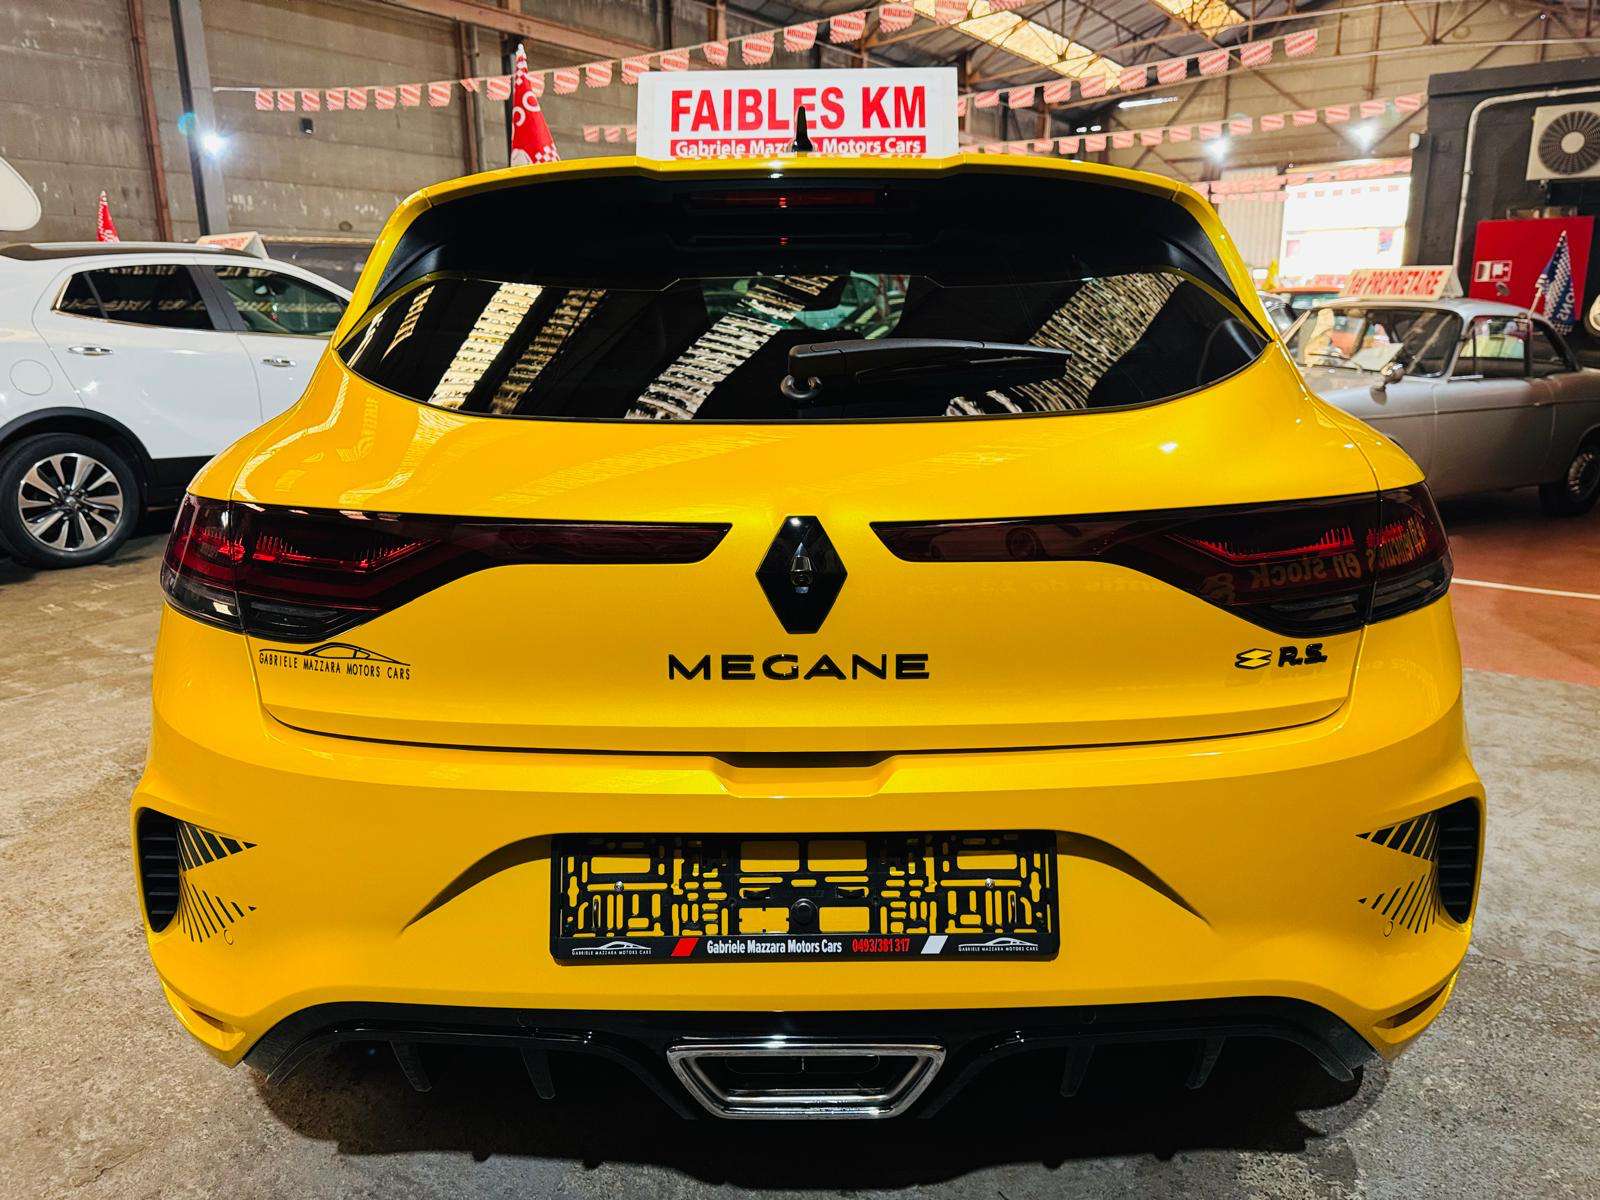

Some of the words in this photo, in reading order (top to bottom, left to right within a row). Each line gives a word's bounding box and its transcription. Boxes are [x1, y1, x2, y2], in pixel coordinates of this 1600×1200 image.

[670, 86, 845, 132] FAIBLES
[862, 86, 926, 129] KM
[675, 140, 746, 157] Gabriele
[822, 138, 881, 154] Motors
[884, 137, 921, 154] Cars
[259, 652, 298, 668] GABRIELE
[303, 659, 341, 674] MAZZARA
[346, 664, 380, 678] MOTORS
[387, 666, 410, 680] CARS
[668, 653, 930, 680] MEGANE
[706, 939, 746, 954] Gabriele
[747, 939, 786, 953] Mazzara
[787, 938, 820, 953] Motors
[821, 938, 843, 953] Cars
